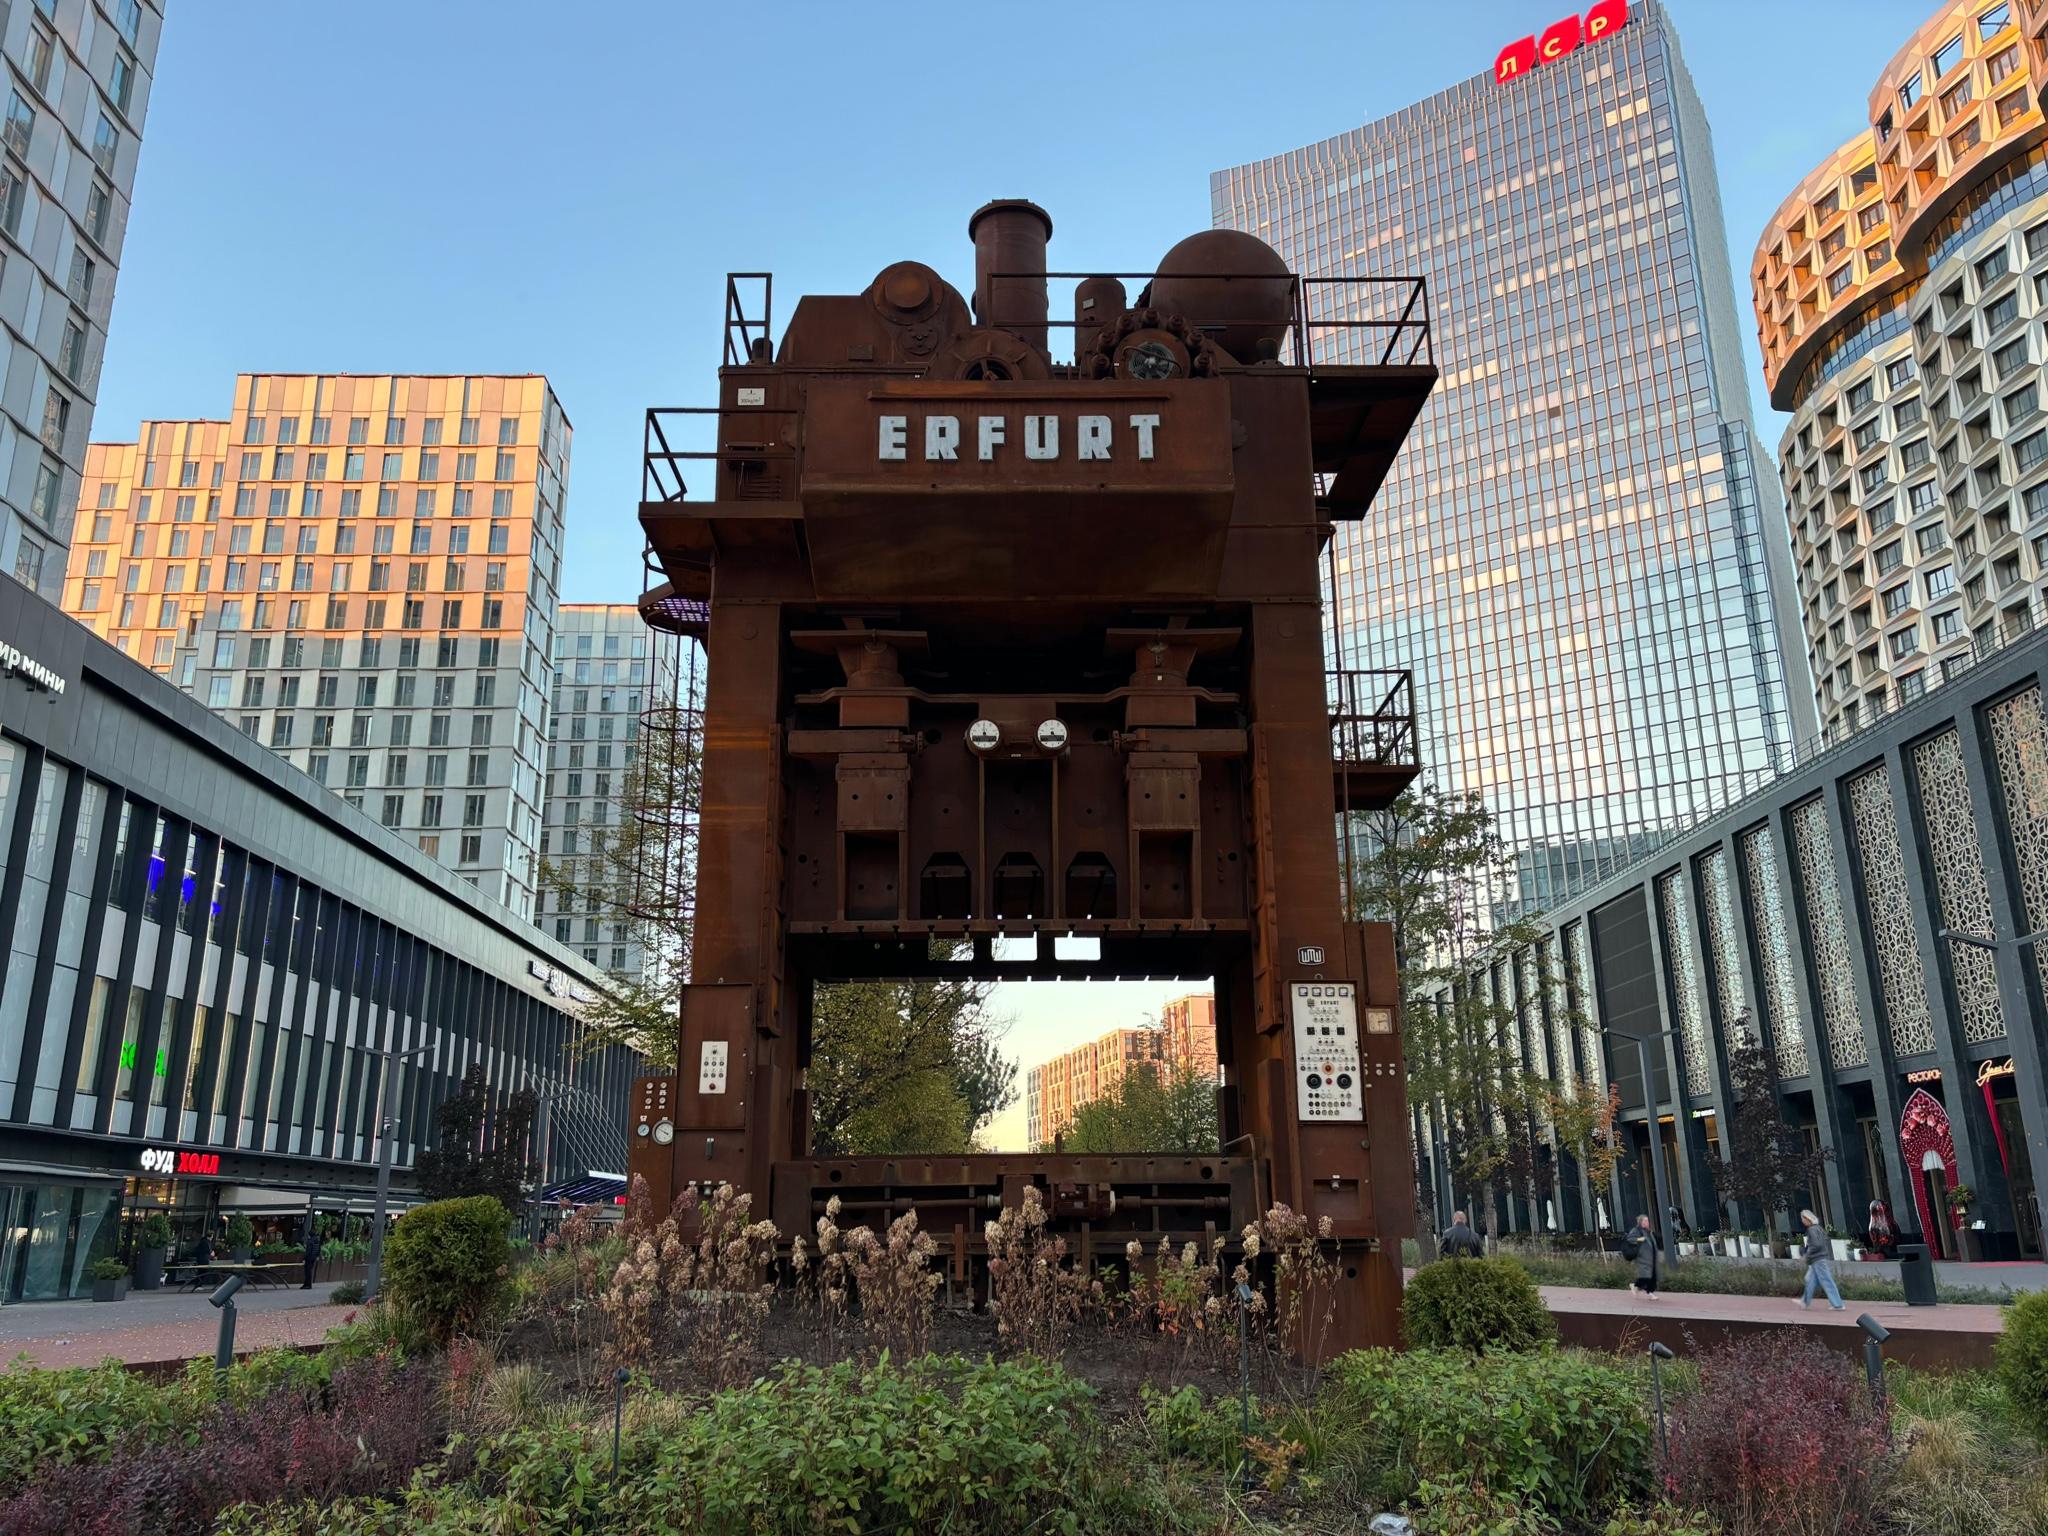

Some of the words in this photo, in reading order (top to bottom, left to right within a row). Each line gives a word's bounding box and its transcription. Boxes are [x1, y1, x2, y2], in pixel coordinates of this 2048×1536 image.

[1500, 16, 1608, 79] ЛСР
[879, 414, 1161, 462] ERFURT
[22, 655, 66, 695] мини
[141, 1148, 175, 1174] ФУД
[178, 1152, 219, 1175] ХОЛЛ
